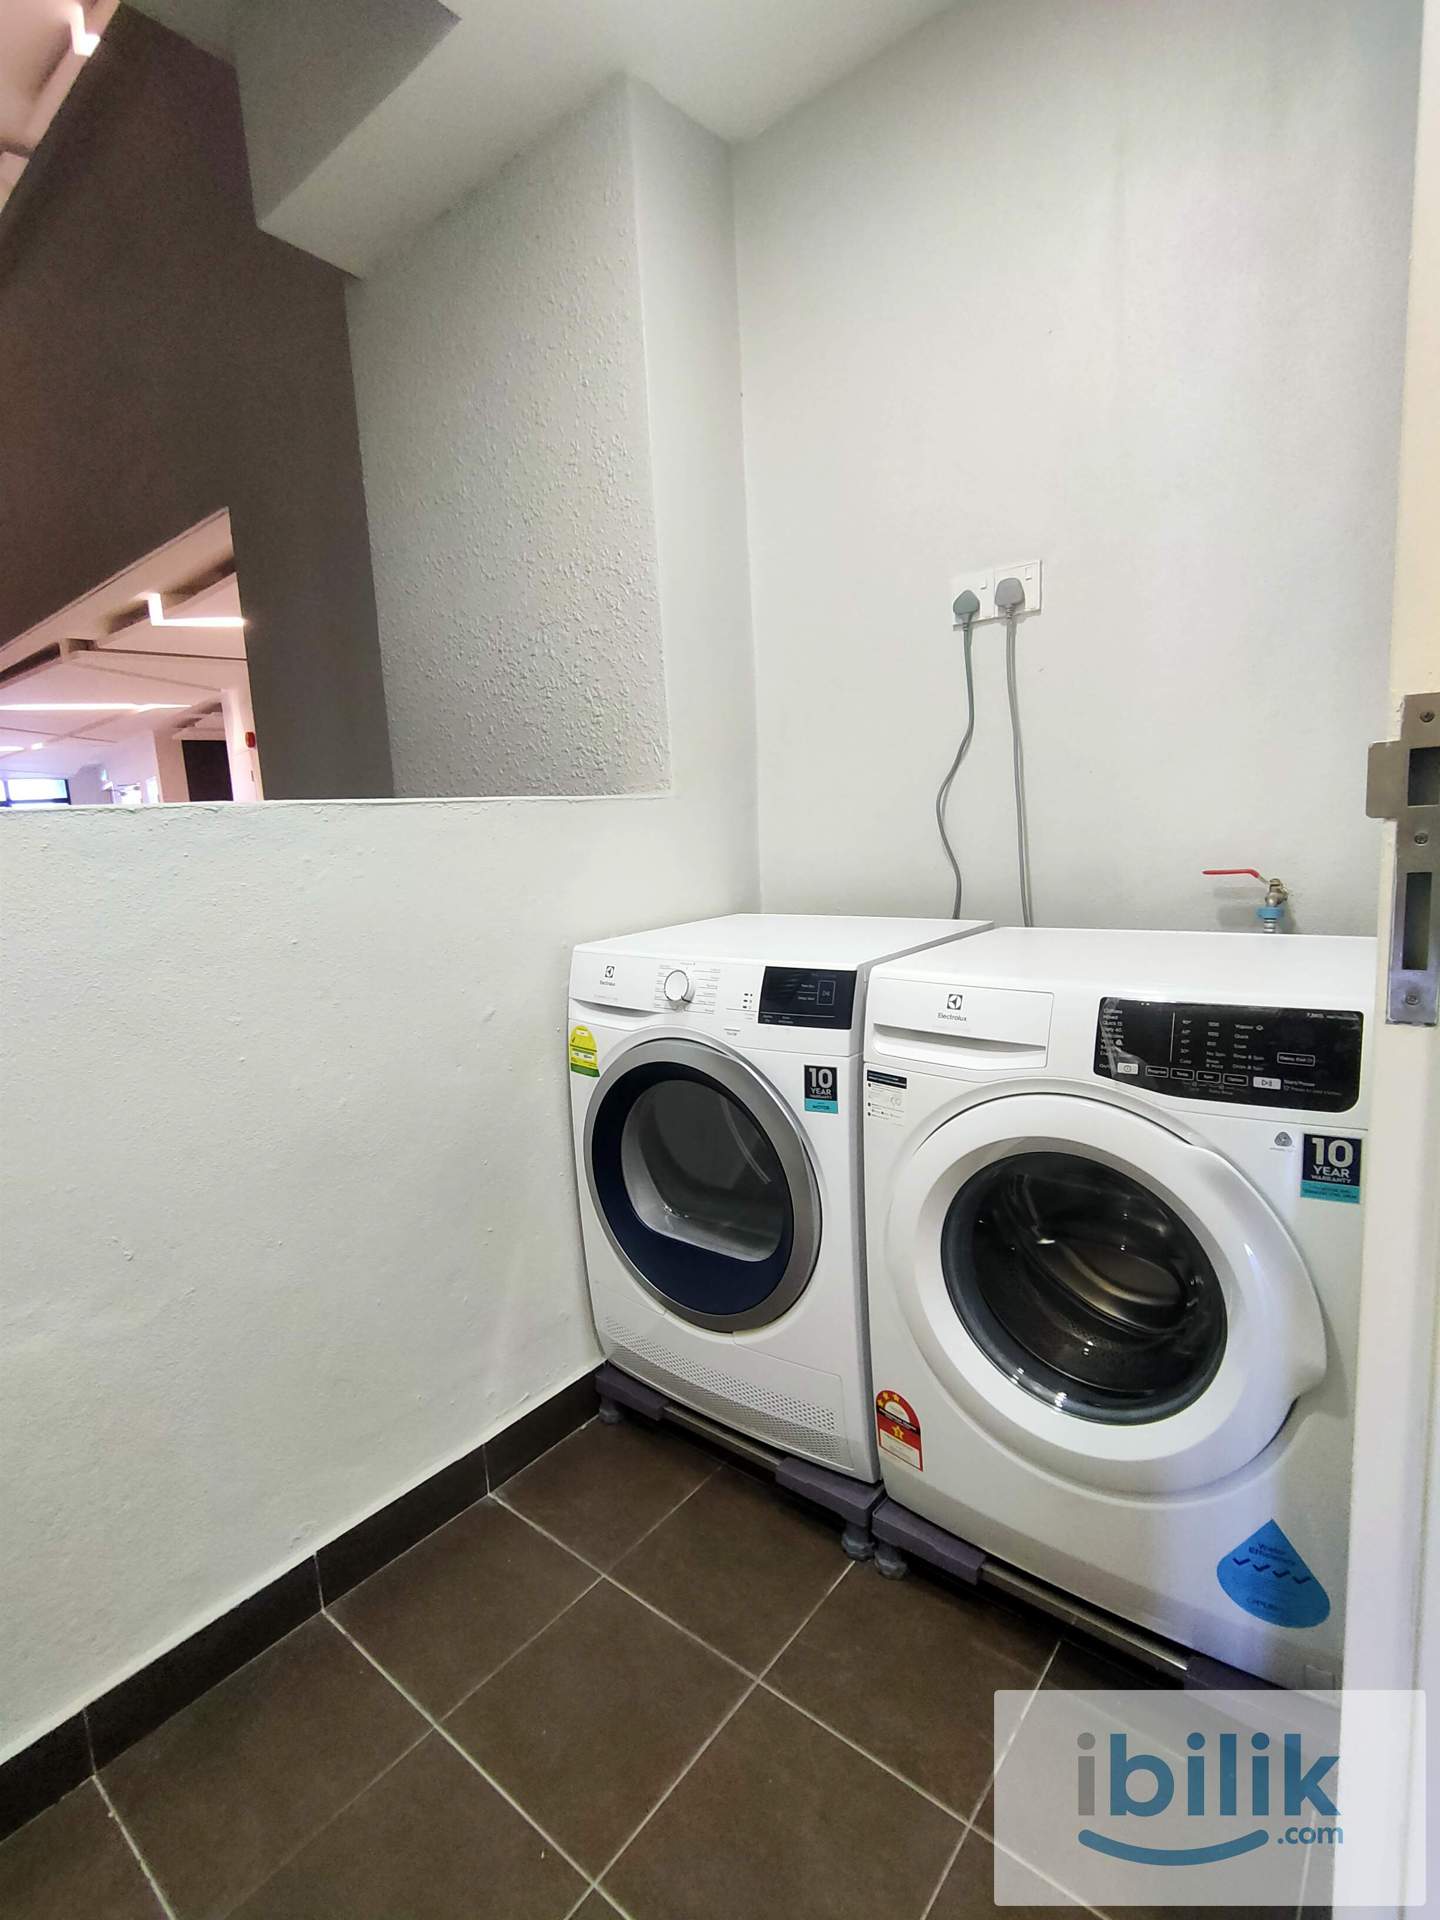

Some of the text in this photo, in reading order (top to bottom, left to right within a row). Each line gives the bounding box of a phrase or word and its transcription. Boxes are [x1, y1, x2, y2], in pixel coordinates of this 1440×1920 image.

[937, 1012, 967, 1022] Electrolux
[808, 1067, 833, 1089] 10
[810, 1087, 832, 1096] YEAR
[1311, 1137, 1353, 1168] 10
[1312, 1165, 1350, 1178] YEAR
[1310, 1174, 1352, 1184] WARRANTY
